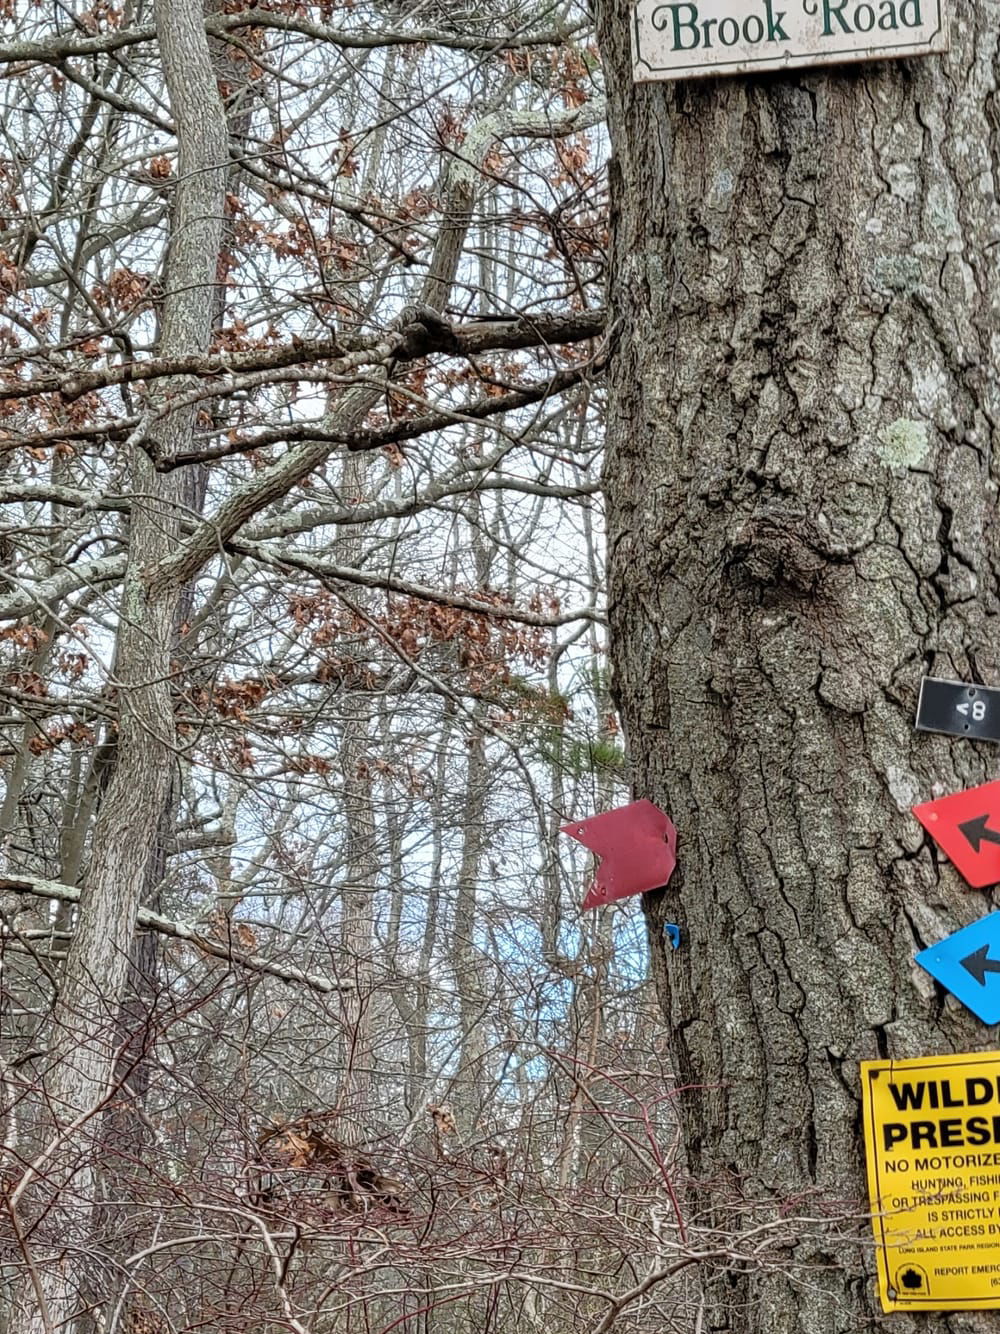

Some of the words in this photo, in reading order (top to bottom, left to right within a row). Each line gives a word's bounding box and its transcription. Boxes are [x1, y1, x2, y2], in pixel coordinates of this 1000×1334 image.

[651, 0, 791, 51] Brook
[803, 0, 923, 36] Road
[885, 1159, 909, 1174] NO
[912, 1176, 966, 1190] HUNTING,
[892, 1197, 909, 1208] OR
[912, 1191, 990, 1208] TRESPASSING
[928, 1211, 938, 1222] IS
[942, 1208, 994, 1221] STRICTLY
[916, 1229, 936, 1238] ALL
[940, 1224, 985, 1238] ACCESS
[934, 1266, 966, 1276] REPORT
